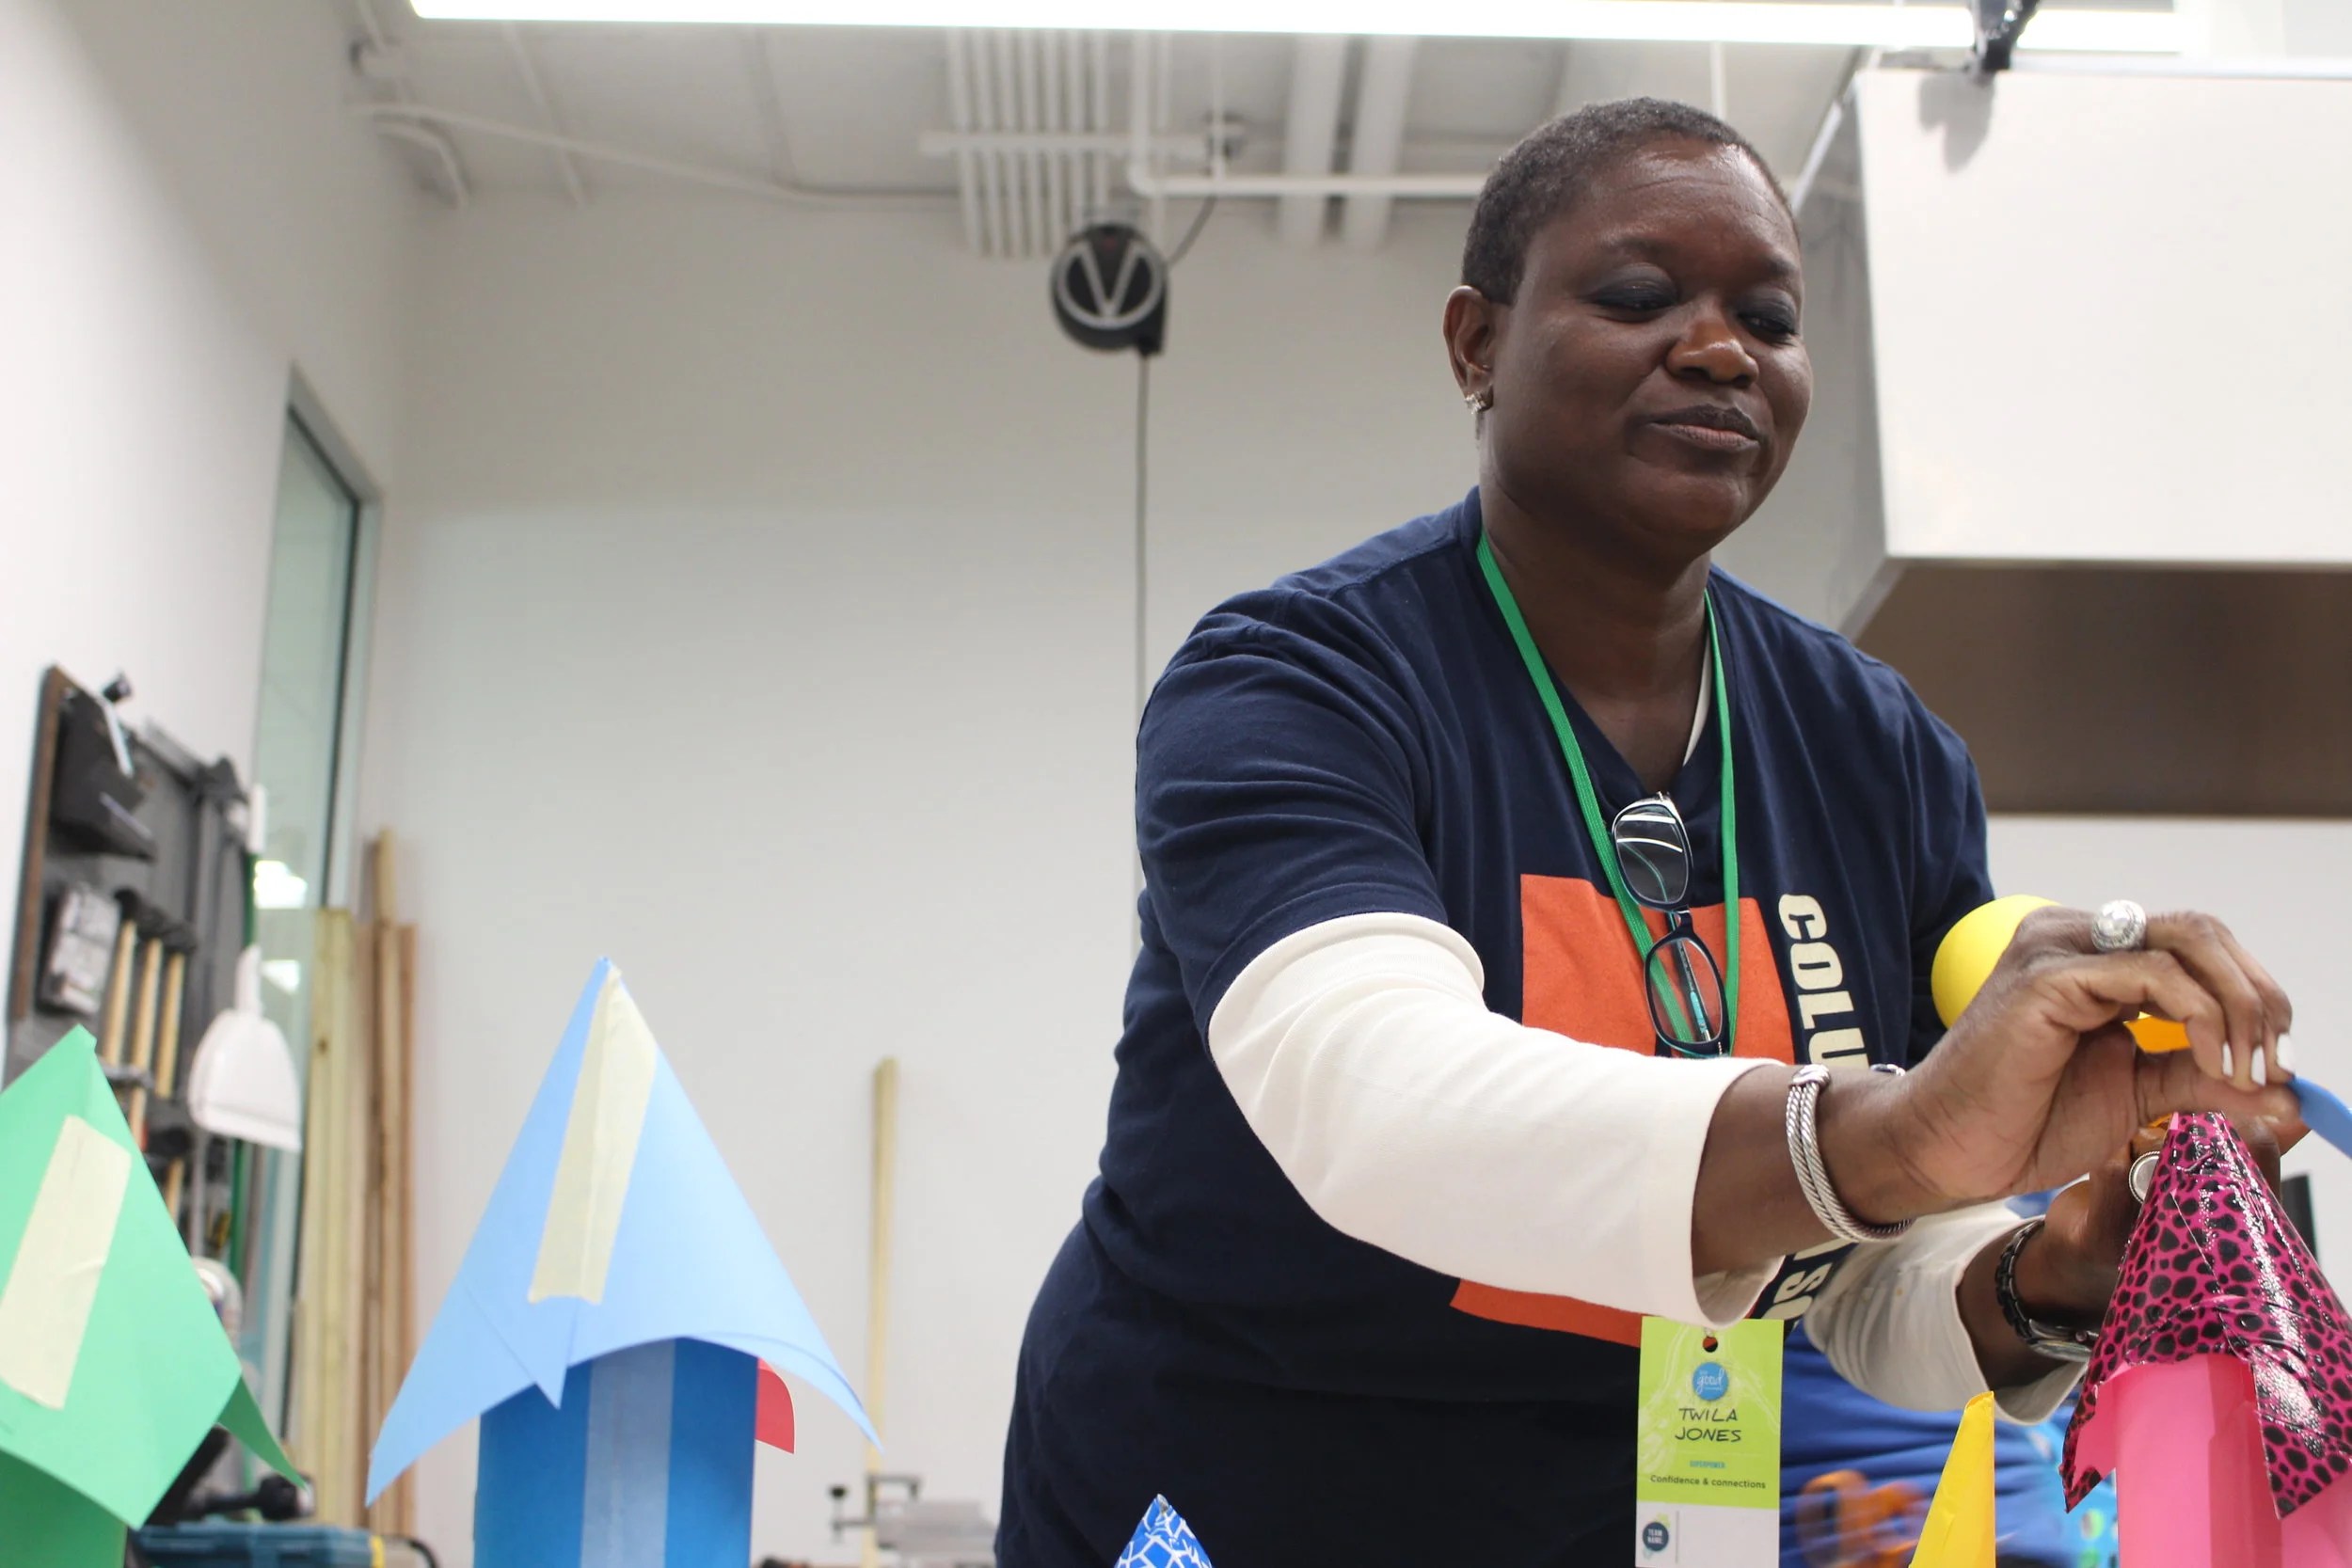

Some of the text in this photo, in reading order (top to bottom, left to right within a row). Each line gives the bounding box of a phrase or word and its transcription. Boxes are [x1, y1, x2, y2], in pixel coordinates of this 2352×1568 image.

[1696, 1368, 1724, 1396] good
[1678, 1407, 1738, 1422] TWILA
[1675, 1426, 1741, 1443] JONES
[1650, 1474, 1767, 1489] Confidence & connections
